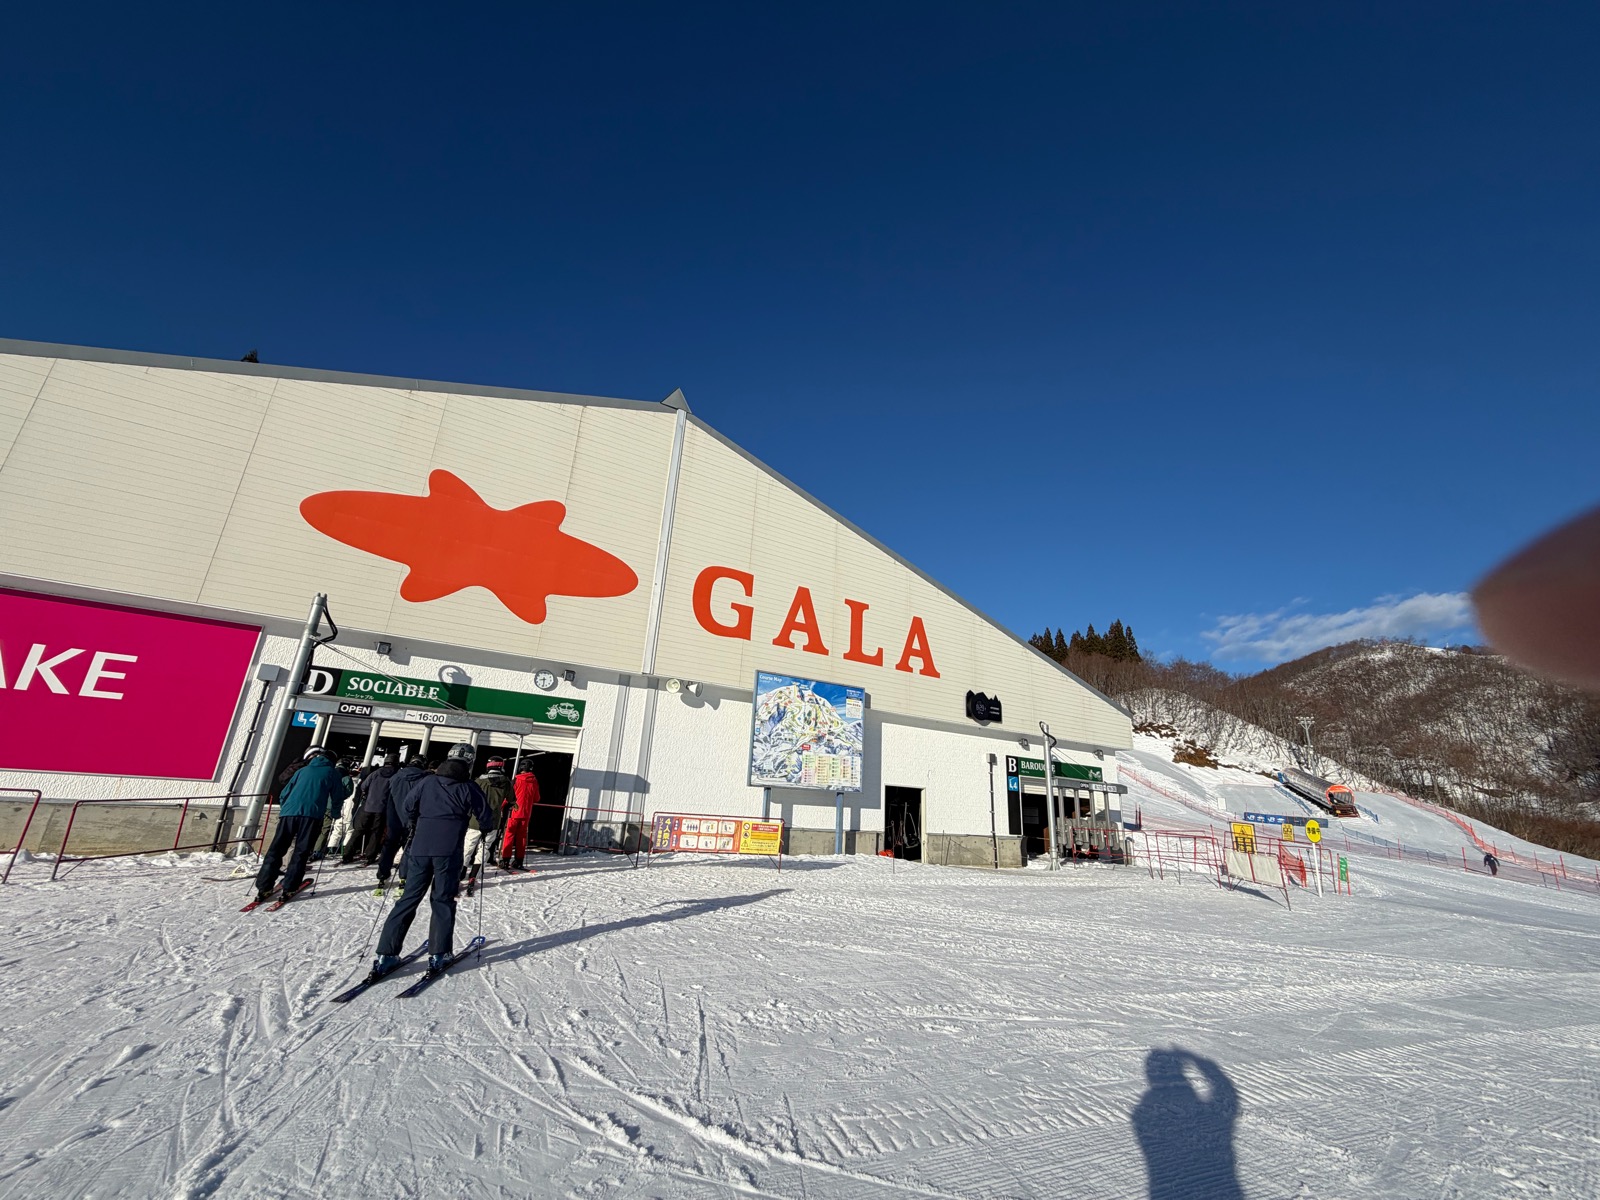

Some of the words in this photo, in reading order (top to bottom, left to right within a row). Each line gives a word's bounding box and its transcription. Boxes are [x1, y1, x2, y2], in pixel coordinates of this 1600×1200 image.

[692, 566, 940, 678] GALA
[0, 643, 138, 700] KE
[303, 669, 334, 695] D
[347, 677, 440, 700] SOCIABLE
[308, 713, 319, 725] 4
[340, 704, 371, 715] OPEN
[1008, 757, 1017, 773] B
